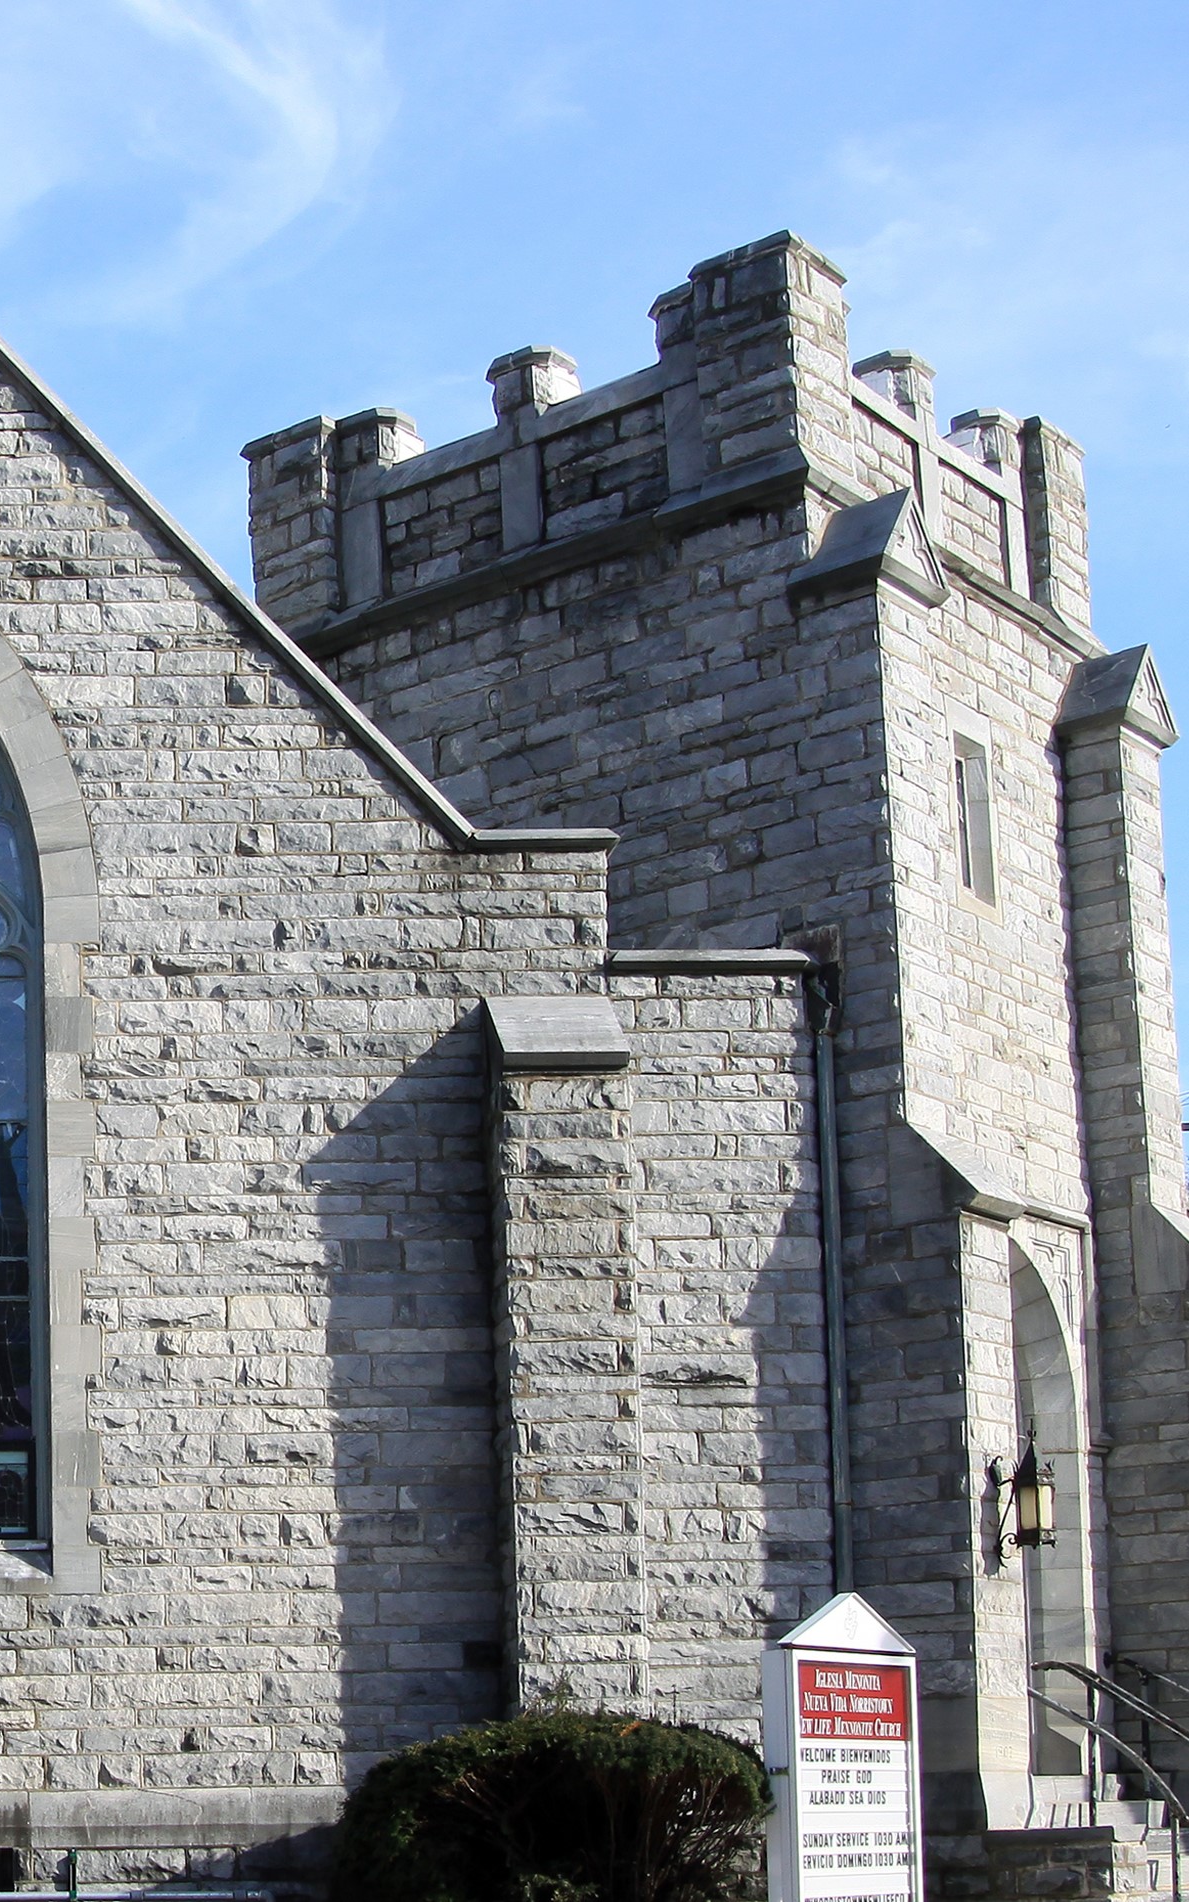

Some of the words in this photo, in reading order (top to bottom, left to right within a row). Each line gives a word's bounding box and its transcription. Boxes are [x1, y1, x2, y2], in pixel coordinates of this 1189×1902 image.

[800, 1716, 813, 1734] EW
[840, 1748, 891, 1763] BIENVENIDOS
[821, 1770, 851, 1784] PRAISE
[856, 1770, 872, 1784] GOD
[809, 1791, 846, 1805] ALABADO
[849, 1791, 864, 1804] SEA
[868, 1791, 887, 1804] DIOS
[803, 1833, 833, 1848] SUNDAY
[836, 1832, 869, 1847] SERVICE
[874, 1832, 893, 1846] 1030
[803, 1854, 833, 1869] ERVICIO
[837, 1853, 872, 1868] DOMINGO
[875, 1853, 893, 1867] 1030
